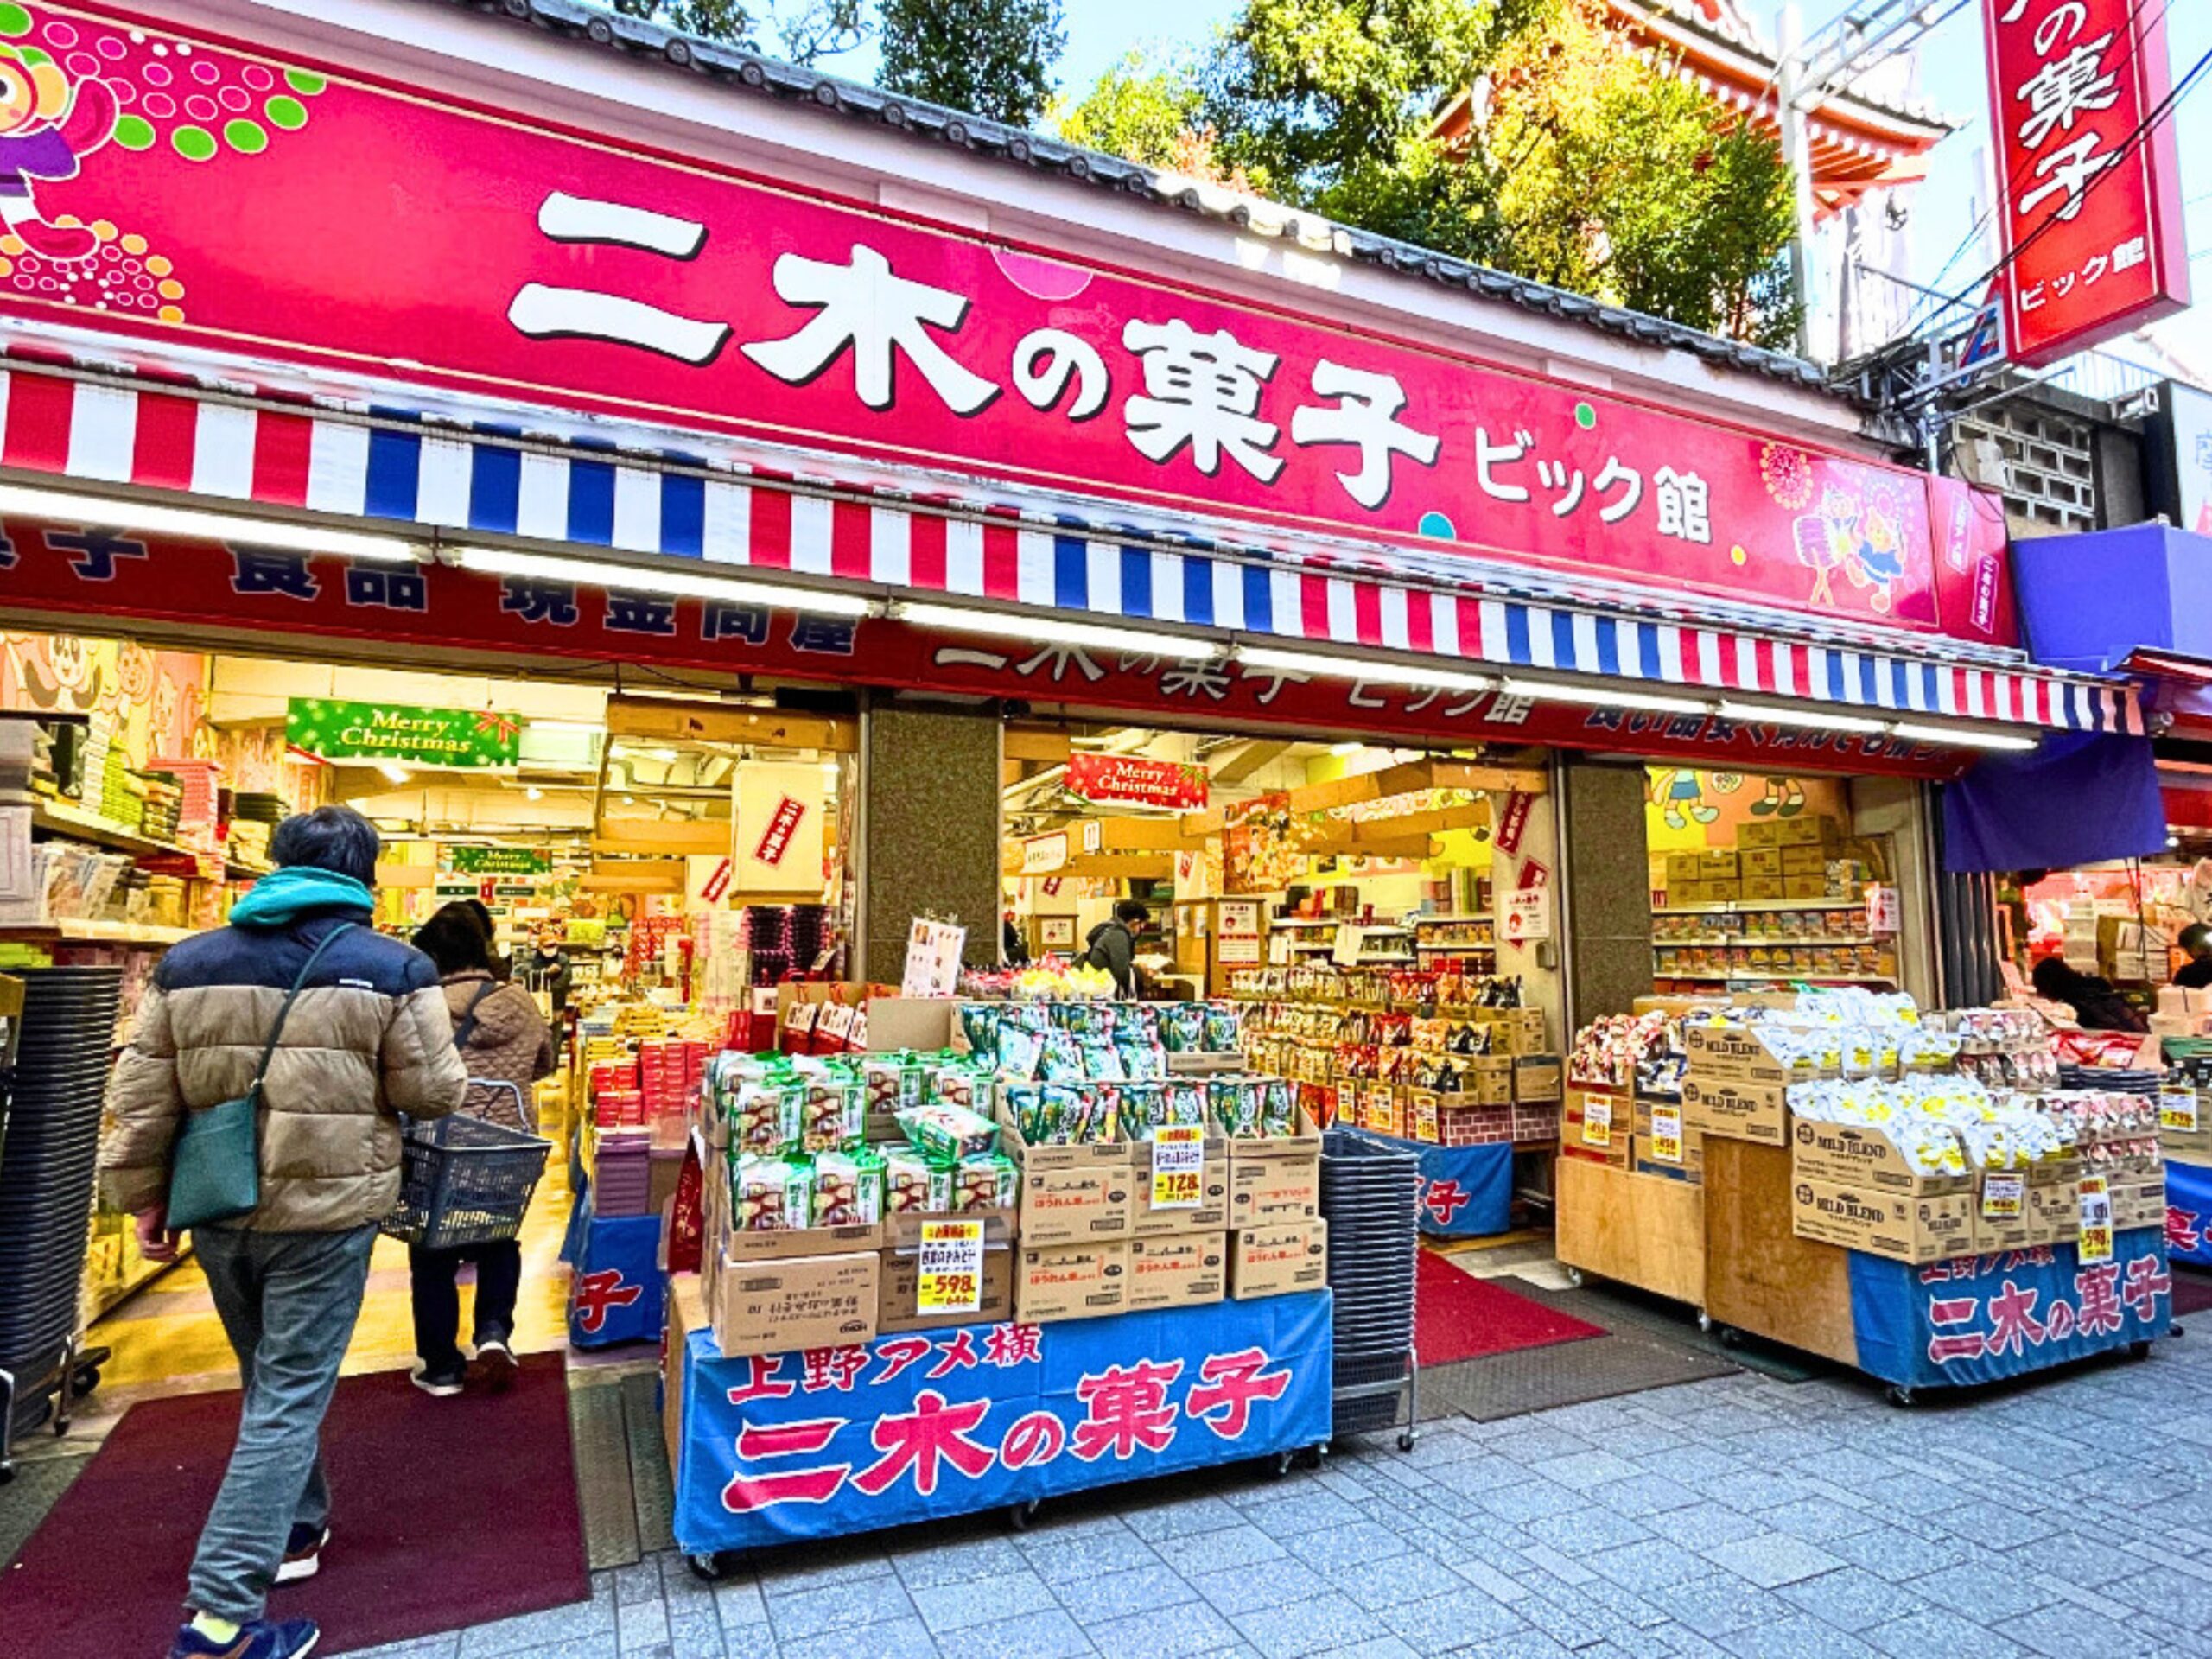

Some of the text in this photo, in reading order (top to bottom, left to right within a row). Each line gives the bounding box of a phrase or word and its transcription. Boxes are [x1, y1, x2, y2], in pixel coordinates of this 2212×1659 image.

[1999, 0, 2124, 221] の菓子
[2020, 236, 2147, 312] ビック館
[506, 191, 1713, 544] 二木の菓子 ビック館
[0, 524, 149, 582] 子
[341, 727, 472, 753] Christmas
[372, 709, 450, 737] Merry
[1098, 774, 1178, 796] Christmas
[1116, 761, 1164, 781] Merry
[1707, 1041, 1759, 1055] MILD BLEND
[1701, 1094, 1757, 1112] MILD BLEND
[1817, 1136, 1886, 1158] MILD BLEND
[1167, 1174, 1198, 1192] 128
[1414, 1176, 1471, 1225] 子
[1817, 1198, 1844, 1213] MILD
[1846, 1205, 1885, 1223] BLEND
[2165, 1205, 2212, 1251] 菓
[574, 1268, 643, 1334] 子
[935, 1274, 972, 1294] 598
[1928, 1253, 2173, 1364] 二木の菓子
[727, 1321, 1043, 1404] 上野アメ横
[721, 1345, 1292, 1513] 二木の菓子
